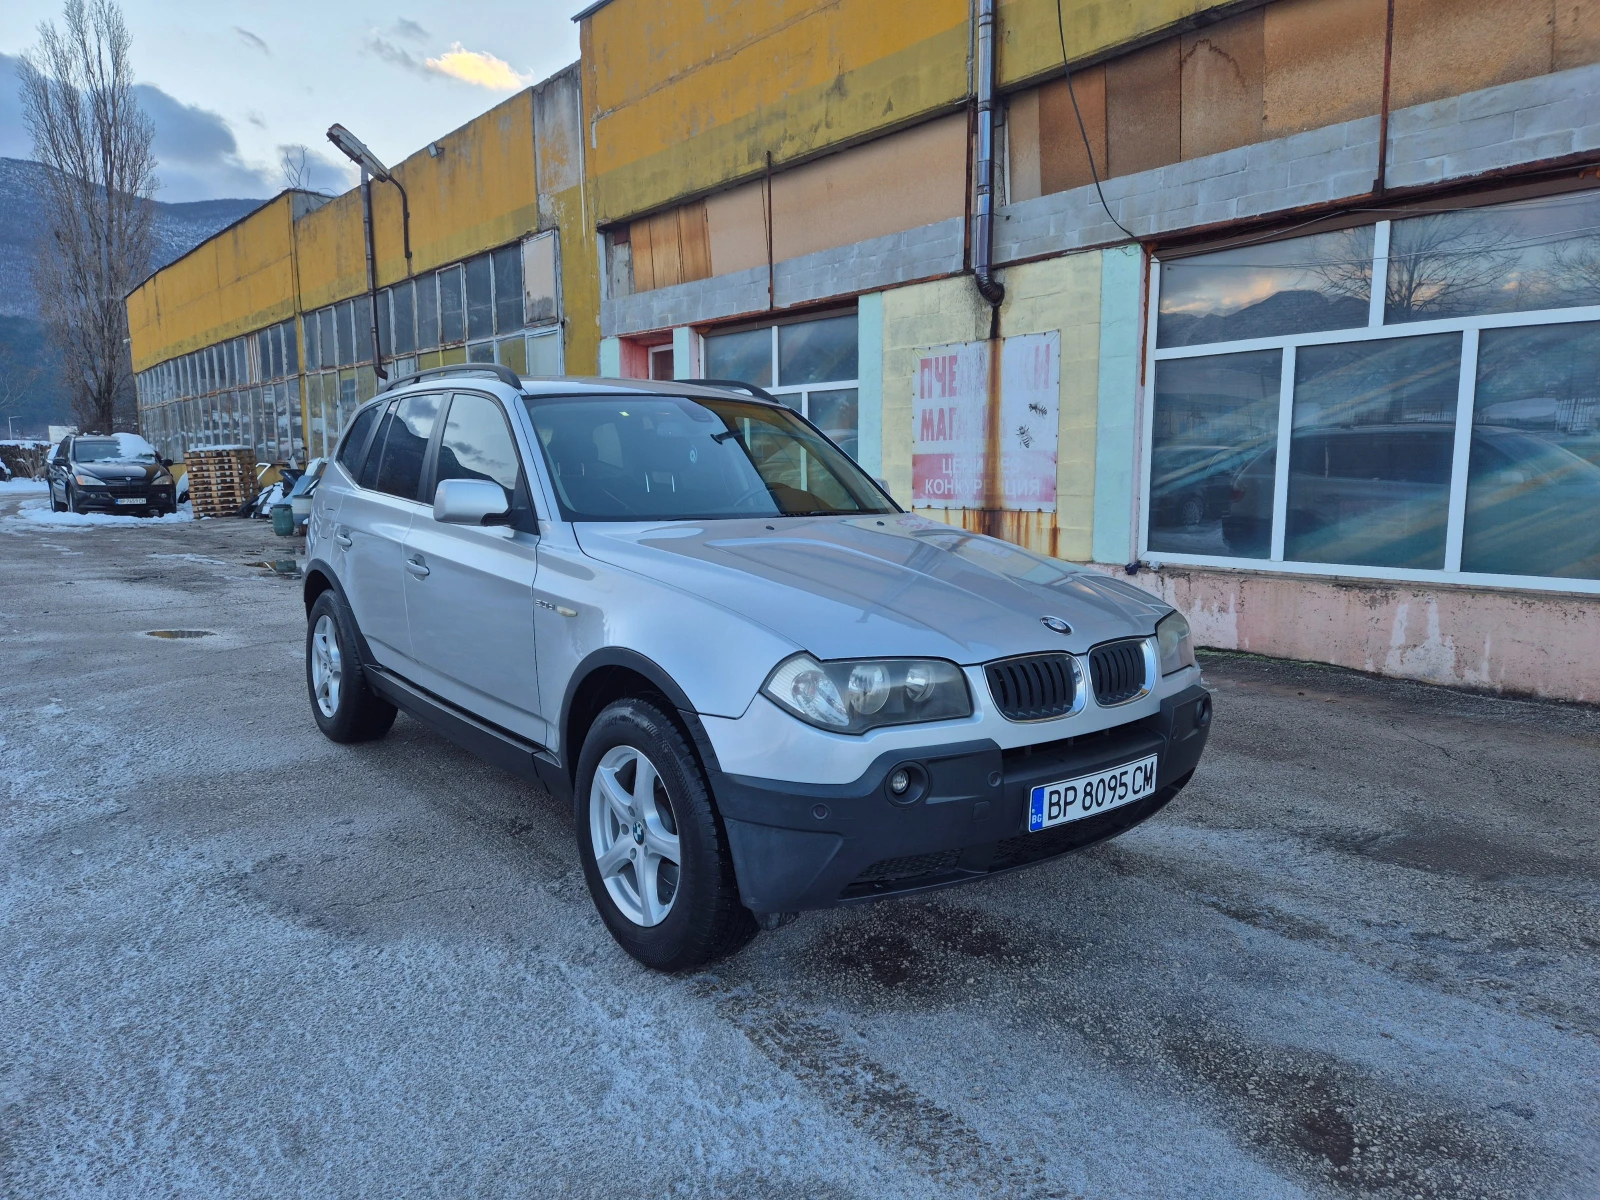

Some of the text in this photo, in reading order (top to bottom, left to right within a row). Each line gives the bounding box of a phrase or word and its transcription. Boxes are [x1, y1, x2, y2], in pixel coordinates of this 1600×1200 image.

[1048, 761, 1154, 821] BP 8095 CM
[1031, 813, 1042, 824] BG
